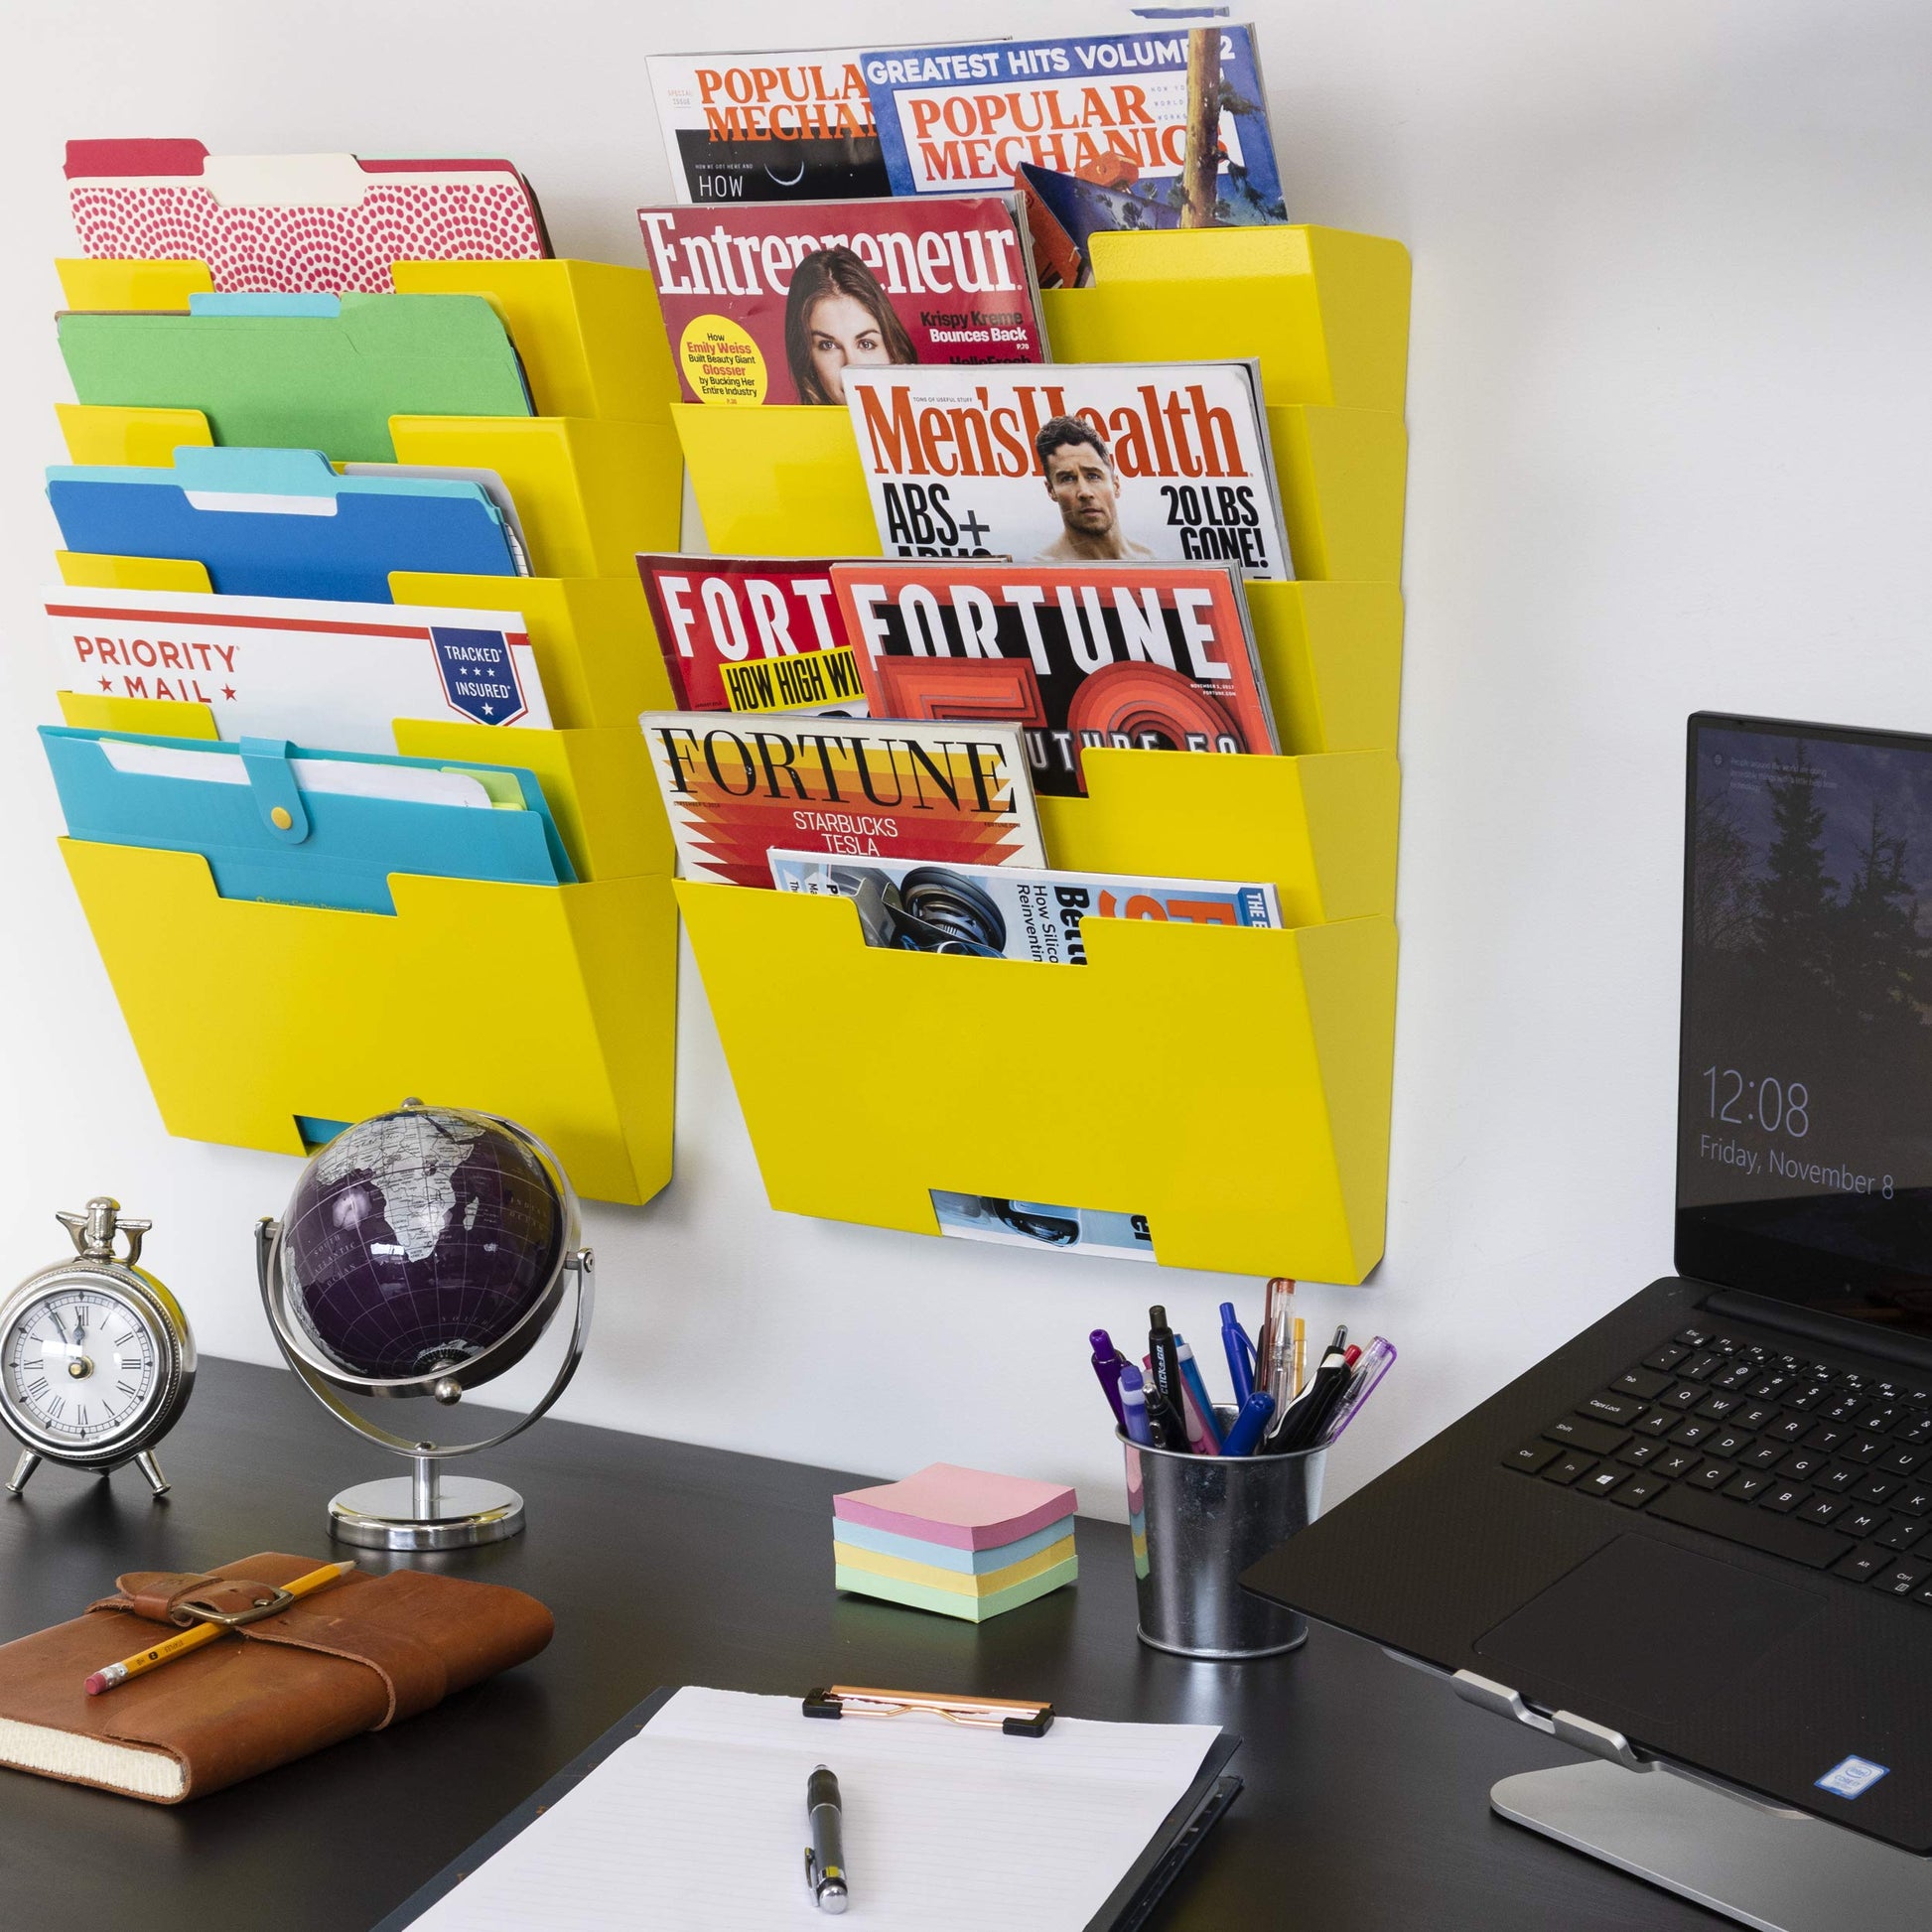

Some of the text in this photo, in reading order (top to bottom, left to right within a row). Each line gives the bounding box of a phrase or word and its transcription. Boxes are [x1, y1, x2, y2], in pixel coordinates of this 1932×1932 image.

[867, 54, 1000, 84] GREATEST
[1008, 49, 1070, 74] HITS
[1220, 35, 1236, 60] 2
[695, 64, 870, 104] POPULA
[908, 84, 1156, 138] POPULAR
[699, 175, 743, 198] HOW
[640, 212, 1018, 296] Entreeneur
[920, 311, 1024, 329] Krispy Kreme
[929, 327, 1028, 343] Bounces Back
[687, 342, 752, 355] Emily Weiss
[707, 354, 734, 364] Beauty
[703, 364, 746, 375] Glossier
[699, 376, 708, 385] by
[710, 377, 741, 387] Bucking
[725, 387, 757, 397] Industry
[1161, 484, 1260, 526] 20 LBS
[1179, 527, 1269, 568] GONE!
[659, 576, 836, 662] FORT
[850, 584, 1232, 680] FORTUNE
[72, 635, 234, 673] PRIORITY
[123, 675, 211, 703] MAIL
[726, 664, 775, 712] HOW
[774, 656, 827, 706] HIGH
[651, 728, 1017, 813] FORTUNE
[793, 811, 898, 837] STARBUCKS
[821, 833, 881, 857] TESLA
[1246, 893, 1264, 917] THE
[1017, 884, 1044, 962] Reinventin
[1034, 885, 1058, 963] How Silico
[1703, 1064, 1809, 1138] 12:08
[1701, 1134, 1894, 1199] Friday, November 8
[1713, 1400, 1729, 1410] W
[1748, 1411, 1762, 1420] E
[1687, 1428, 1700, 1437] S
[1785, 1422, 1798, 1431] R
[1862, 1444, 1874, 1452] Y
[1669, 1458, 1684, 1467] X
[1743, 1480, 1755, 1489] V
[1833, 1472, 1848, 1481] H
[1779, 1492, 1792, 1501] B
[1910, 1496, 1926, 1505] K
[1817, 1504, 1833, 1513] N
[1855, 1516, 1871, 1526] M
